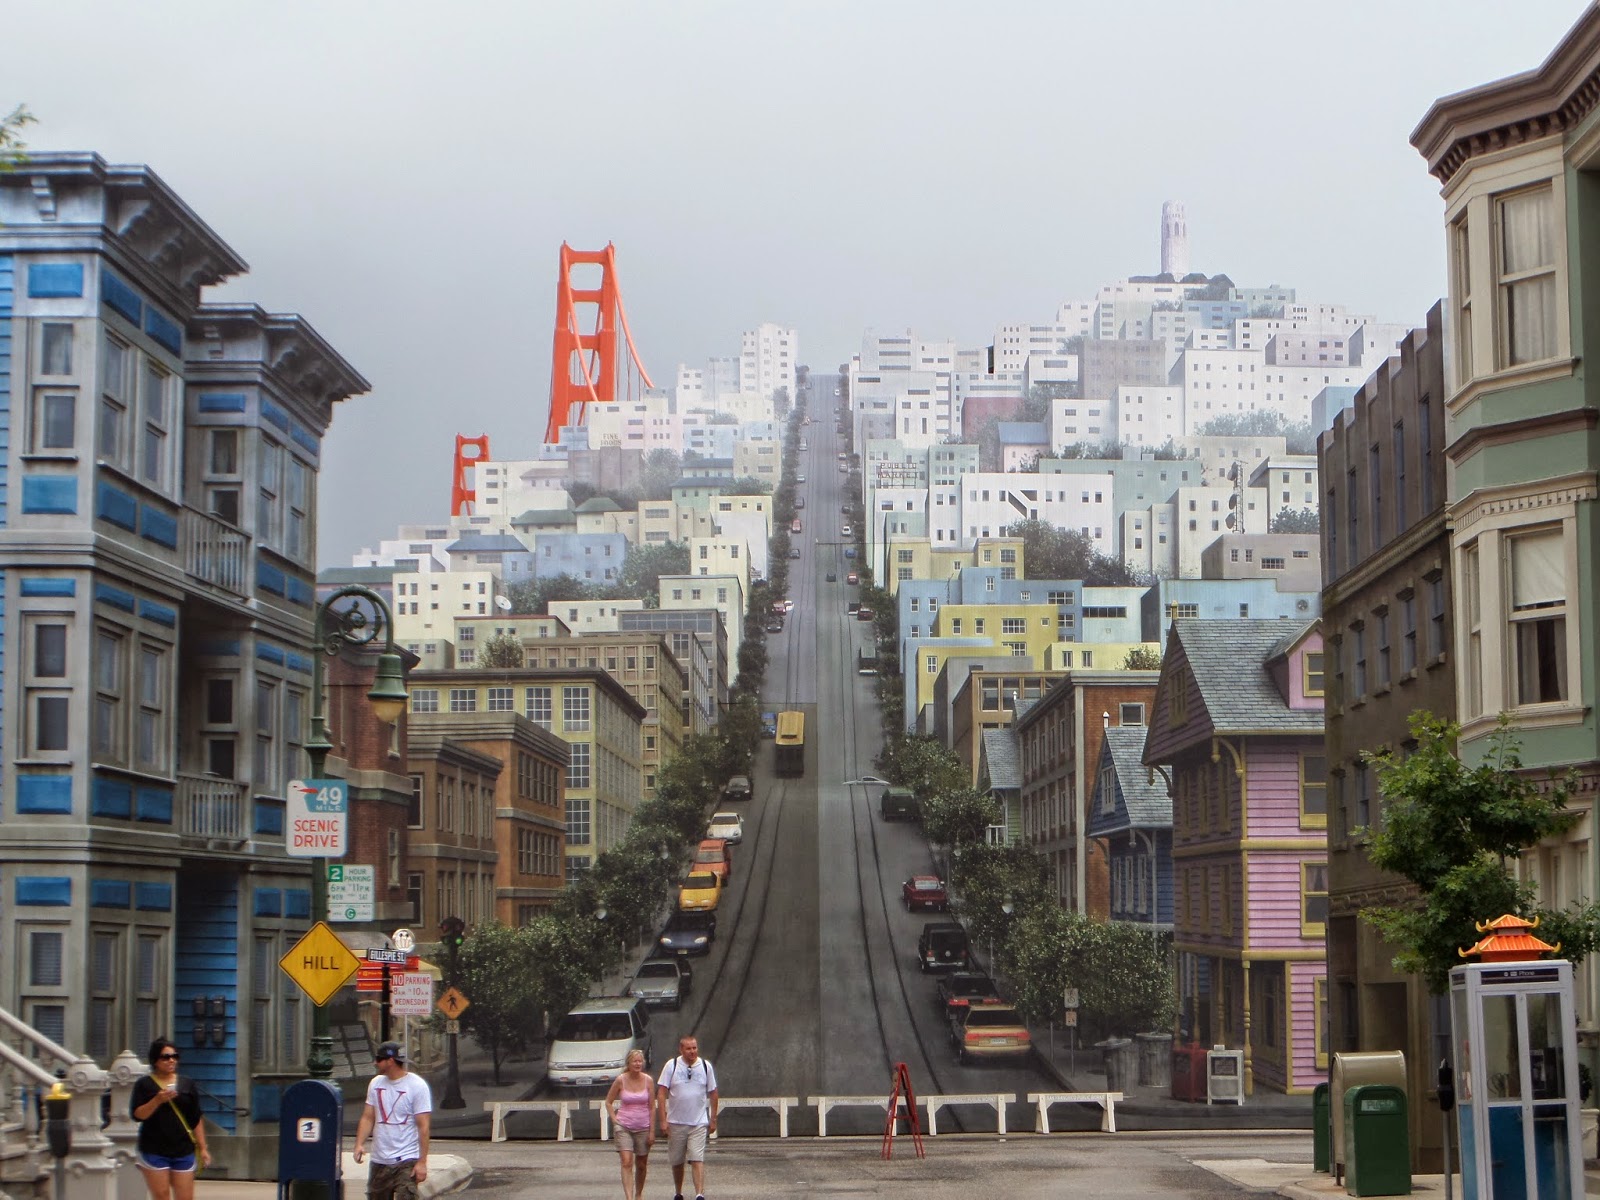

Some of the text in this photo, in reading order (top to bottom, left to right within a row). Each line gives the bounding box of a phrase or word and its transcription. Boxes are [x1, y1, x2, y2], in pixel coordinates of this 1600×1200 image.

[880, 462, 917, 470] PUBLIC
[877, 471, 919, 479] MARKET
[316, 787, 343, 805] 49
[294, 820, 339, 832] SCENIC
[294, 835, 339, 848] DRIVE
[331, 868, 341, 880] 2
[370, 950, 397, 961] GILLESPIE
[303, 956, 339, 970] HILL
[392, 974, 404, 985] NO
[405, 976, 431, 985] PARKING
